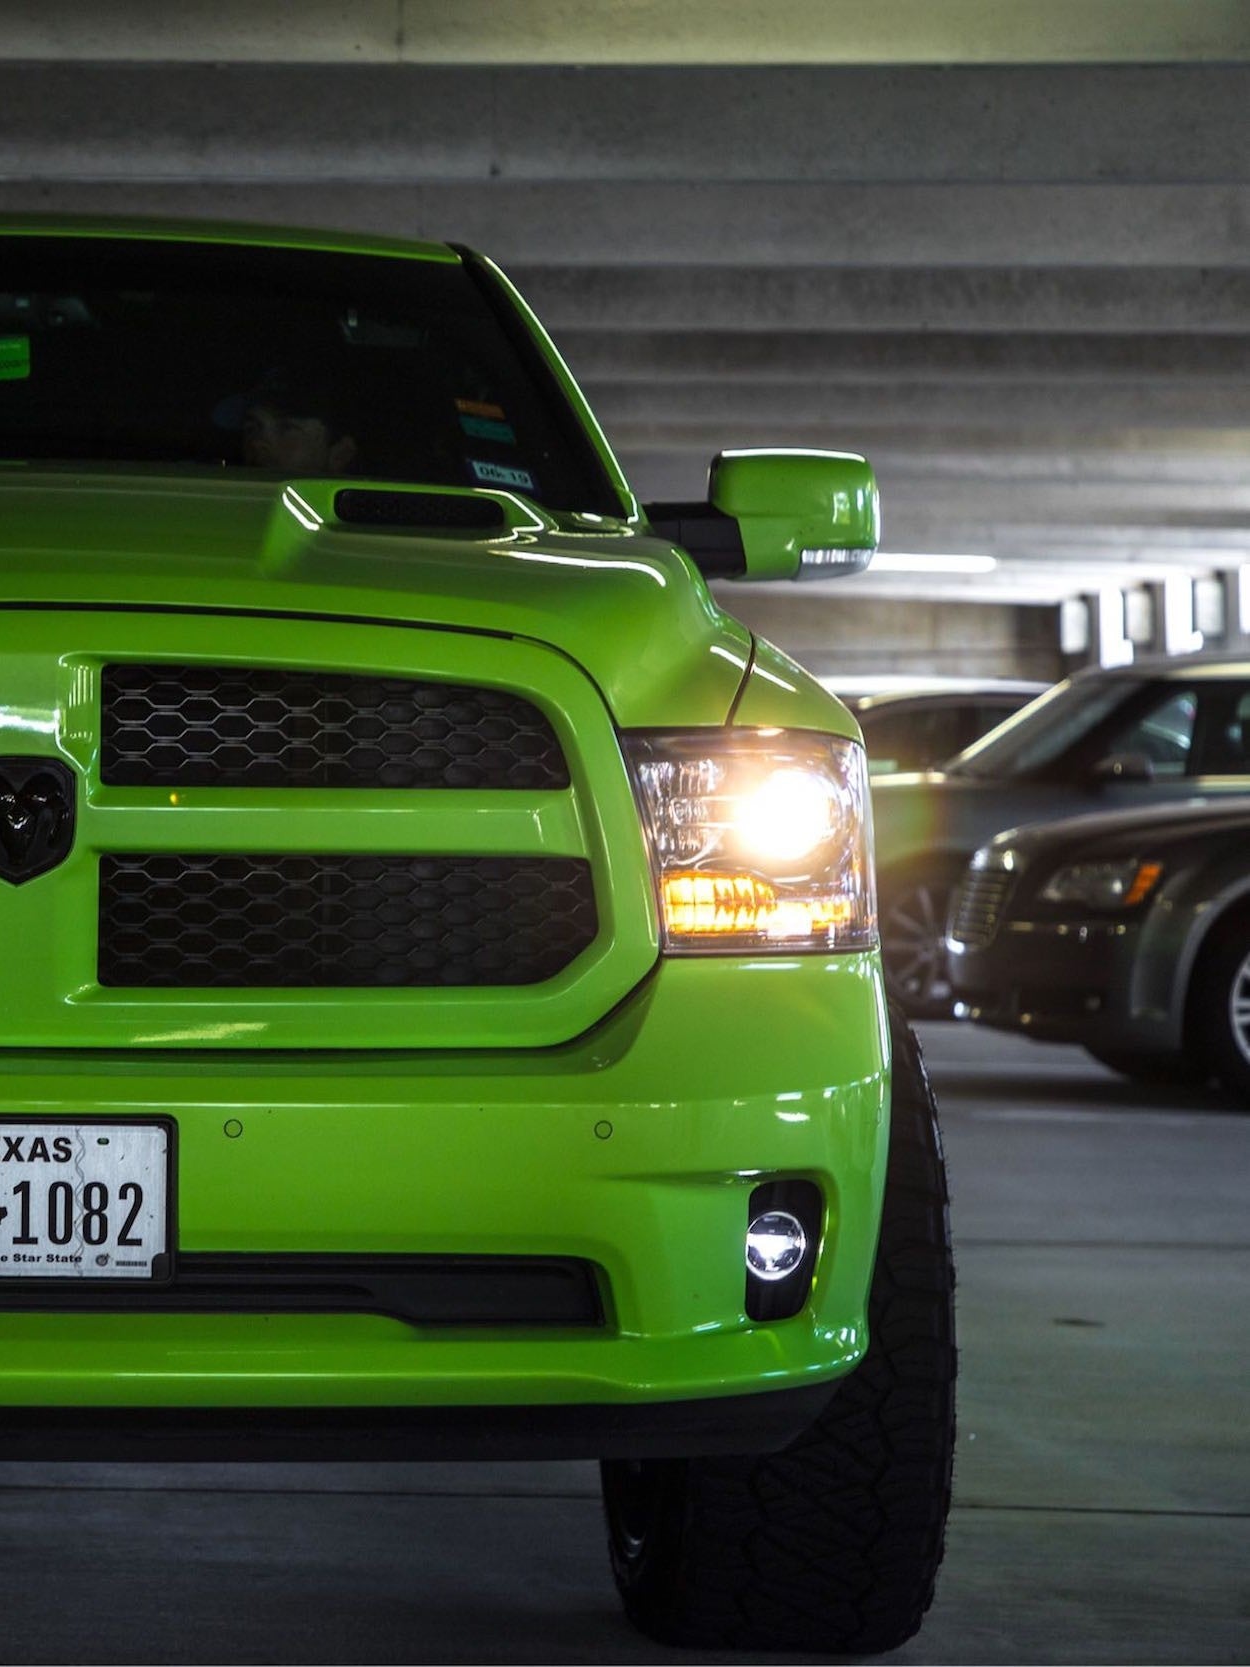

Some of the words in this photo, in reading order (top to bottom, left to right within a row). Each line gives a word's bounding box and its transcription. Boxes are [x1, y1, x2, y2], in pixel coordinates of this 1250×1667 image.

[12, 1180, 143, 1247] 1082
[12, 1253, 42, 1263] Star
[46, 1253, 83, 1263] State
